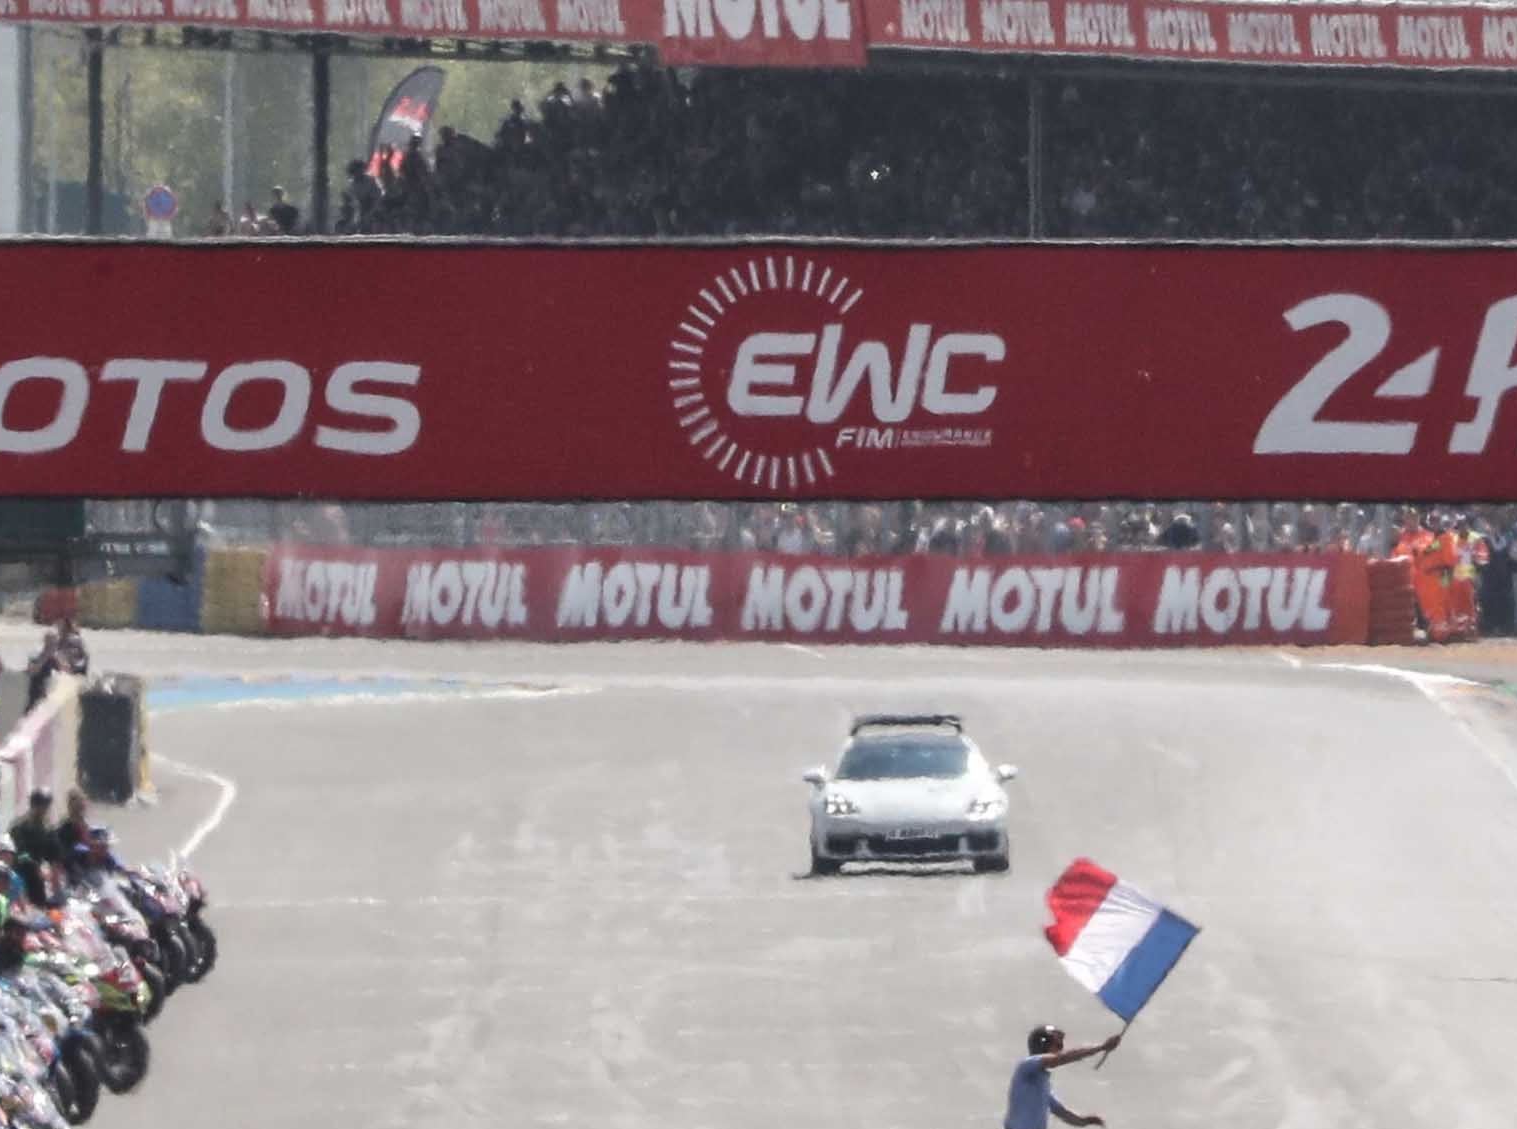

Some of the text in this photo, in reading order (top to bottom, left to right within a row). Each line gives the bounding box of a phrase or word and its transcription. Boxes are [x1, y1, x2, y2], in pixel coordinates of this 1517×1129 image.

[726, 321, 1007, 426] EWC
[834, 426, 895, 449] FIM
[403, 560, 527, 627] MOTUL
[557, 560, 713, 631] MOTUL
[741, 562, 908, 633] MOTUL
[940, 565, 1125, 633] MOTUL
[1153, 566, 1332, 634] MOTUL
